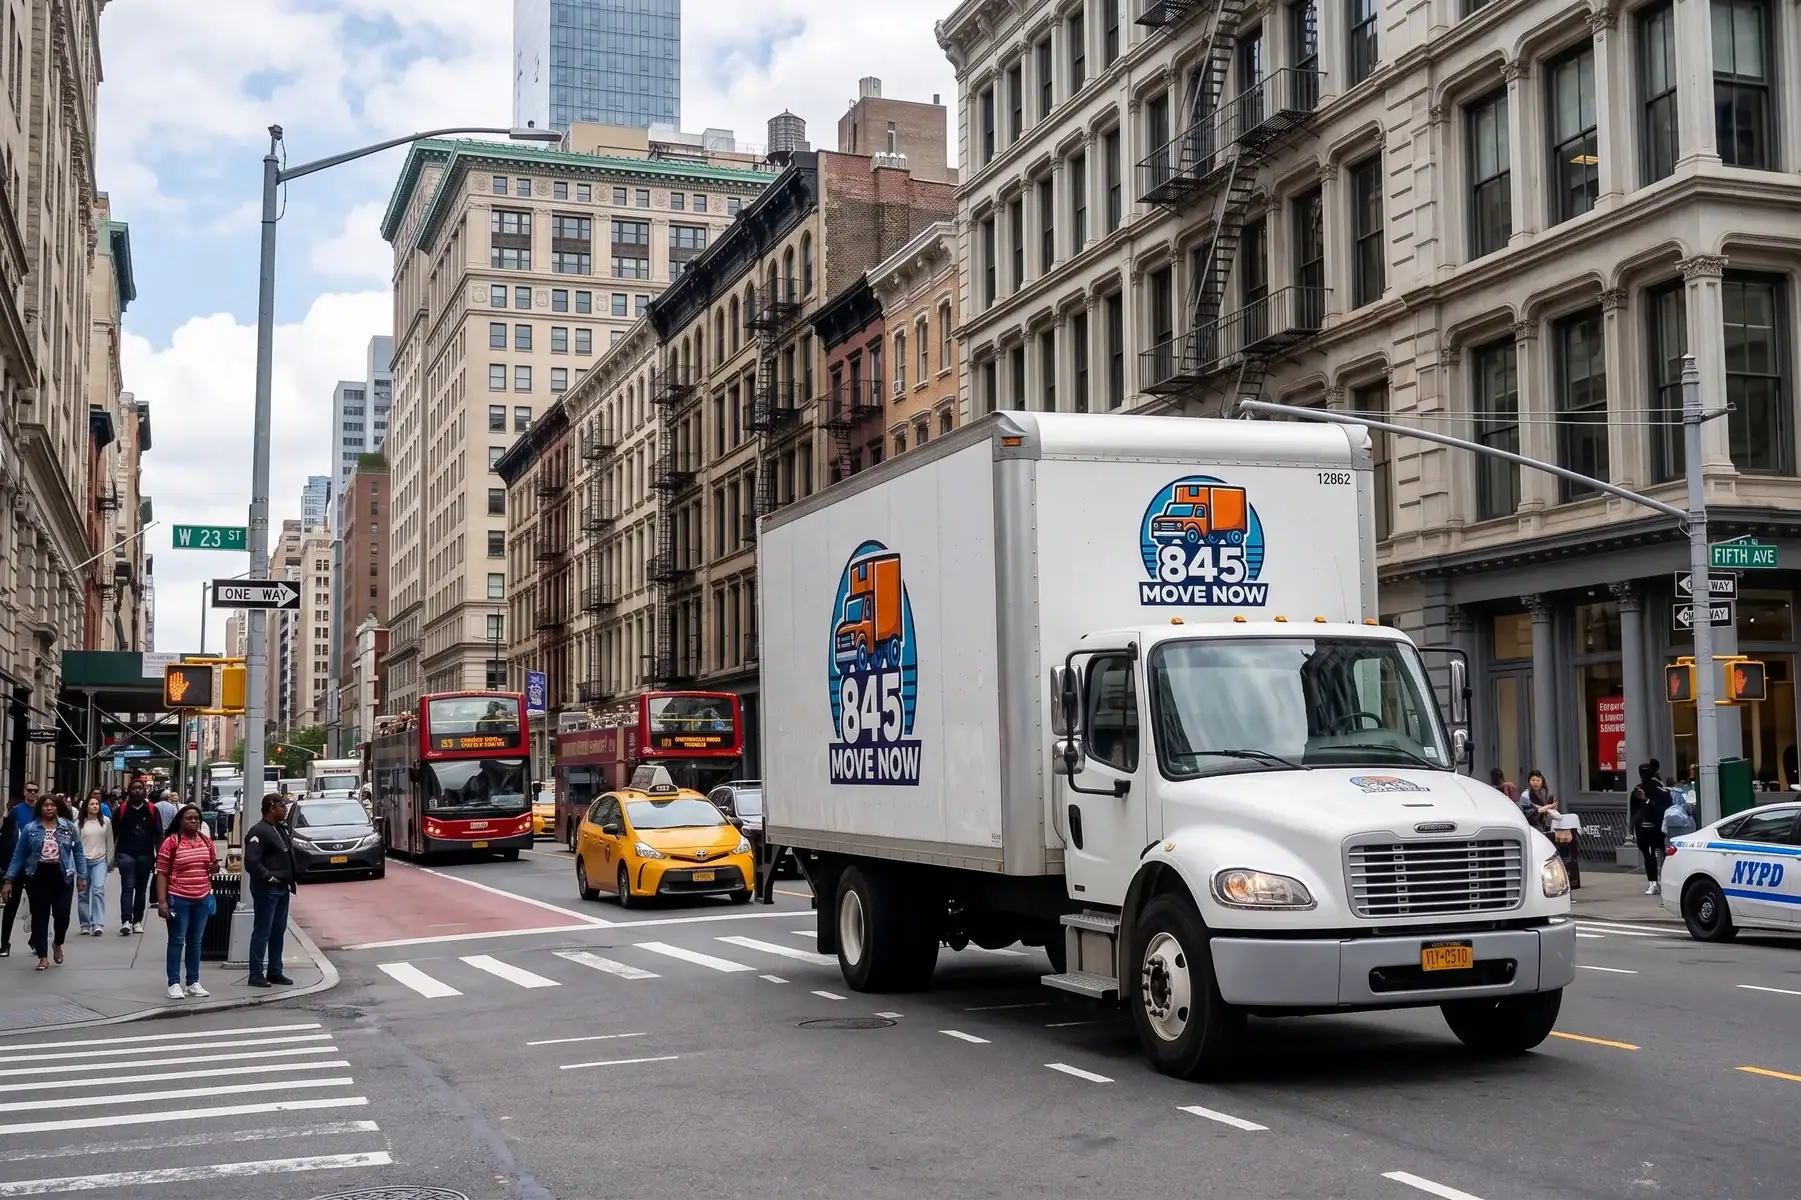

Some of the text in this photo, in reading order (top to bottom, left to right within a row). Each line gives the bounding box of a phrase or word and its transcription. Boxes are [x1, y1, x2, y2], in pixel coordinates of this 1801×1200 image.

[1317, 472, 1351, 485] 12862
[179, 528, 241, 547] W 23 ST
[1161, 545, 1245, 583] 845
[1714, 548, 1775, 564] FIFTH AVE
[225, 588, 289, 601] ONE WAY
[1142, 585, 1266, 604] MOVE NOW
[1710, 580, 1730, 591] WAY
[842, 672, 901, 744] 845
[831, 746, 920, 780] MOVE NOW
[1731, 860, 1784, 887] NYPD
